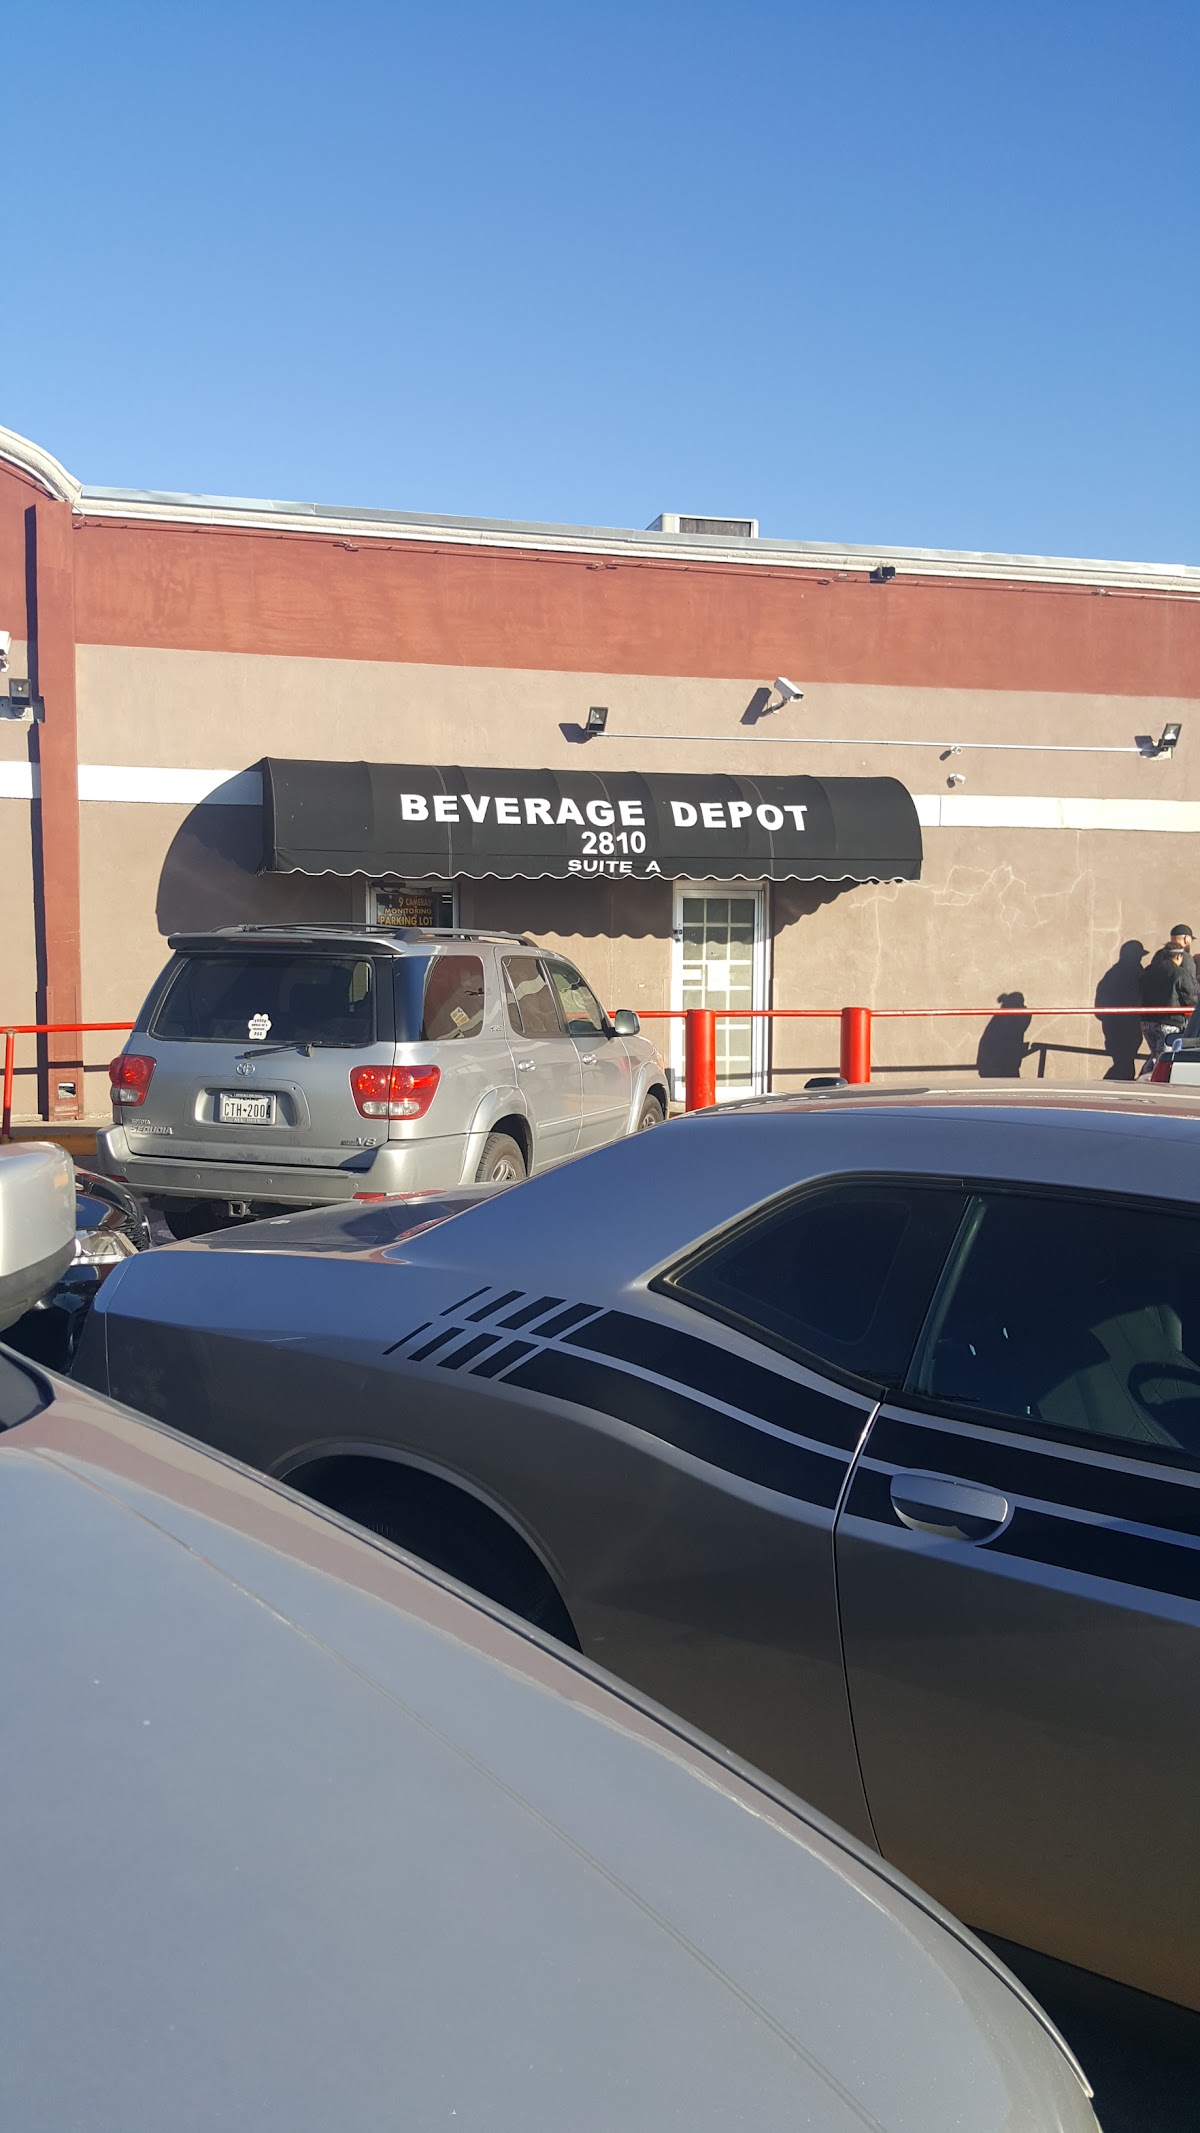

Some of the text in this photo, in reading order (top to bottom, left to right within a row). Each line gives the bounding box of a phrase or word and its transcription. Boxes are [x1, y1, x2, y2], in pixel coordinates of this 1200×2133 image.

[400, 793, 808, 831] BEVERAGE DEPOT
[581, 831, 646, 855] 2810
[567, 859, 662, 874] SUITE A
[398, 896, 432, 907] 9 CAMERAS
[380, 915, 433, 926] PARKING LOT
